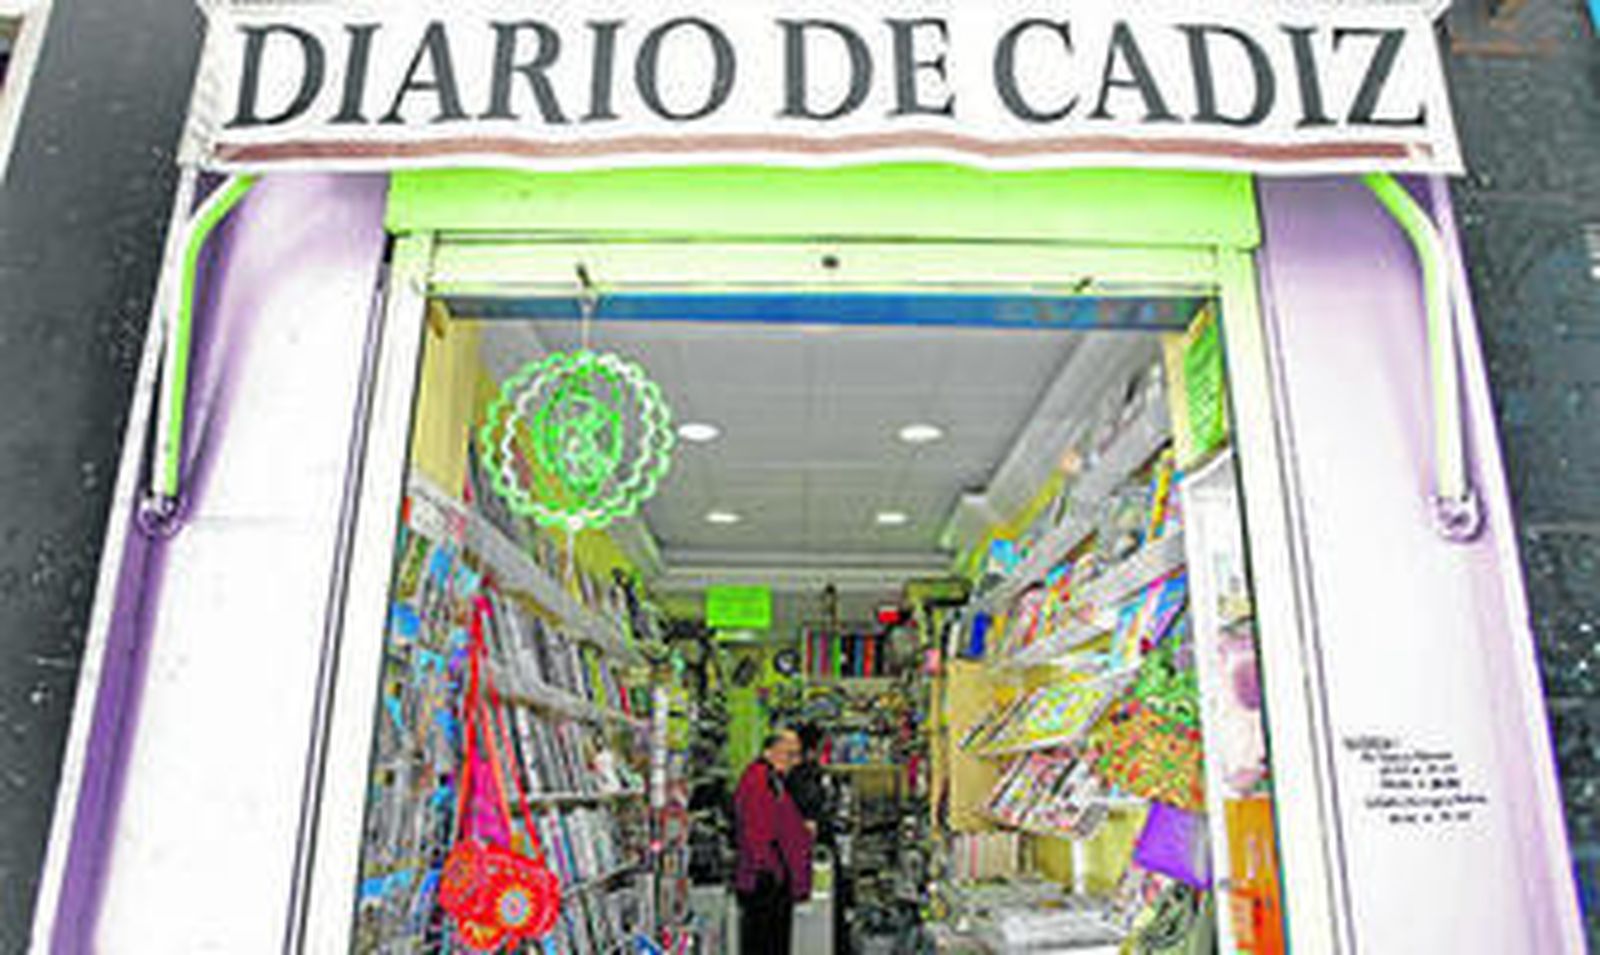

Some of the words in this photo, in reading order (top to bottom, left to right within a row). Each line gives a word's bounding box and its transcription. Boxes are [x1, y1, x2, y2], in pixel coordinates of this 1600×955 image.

[224, 17, 736, 129] DIARIO
[775, 17, 956, 121] DE
[993, 18, 1427, 128] CADIZ
